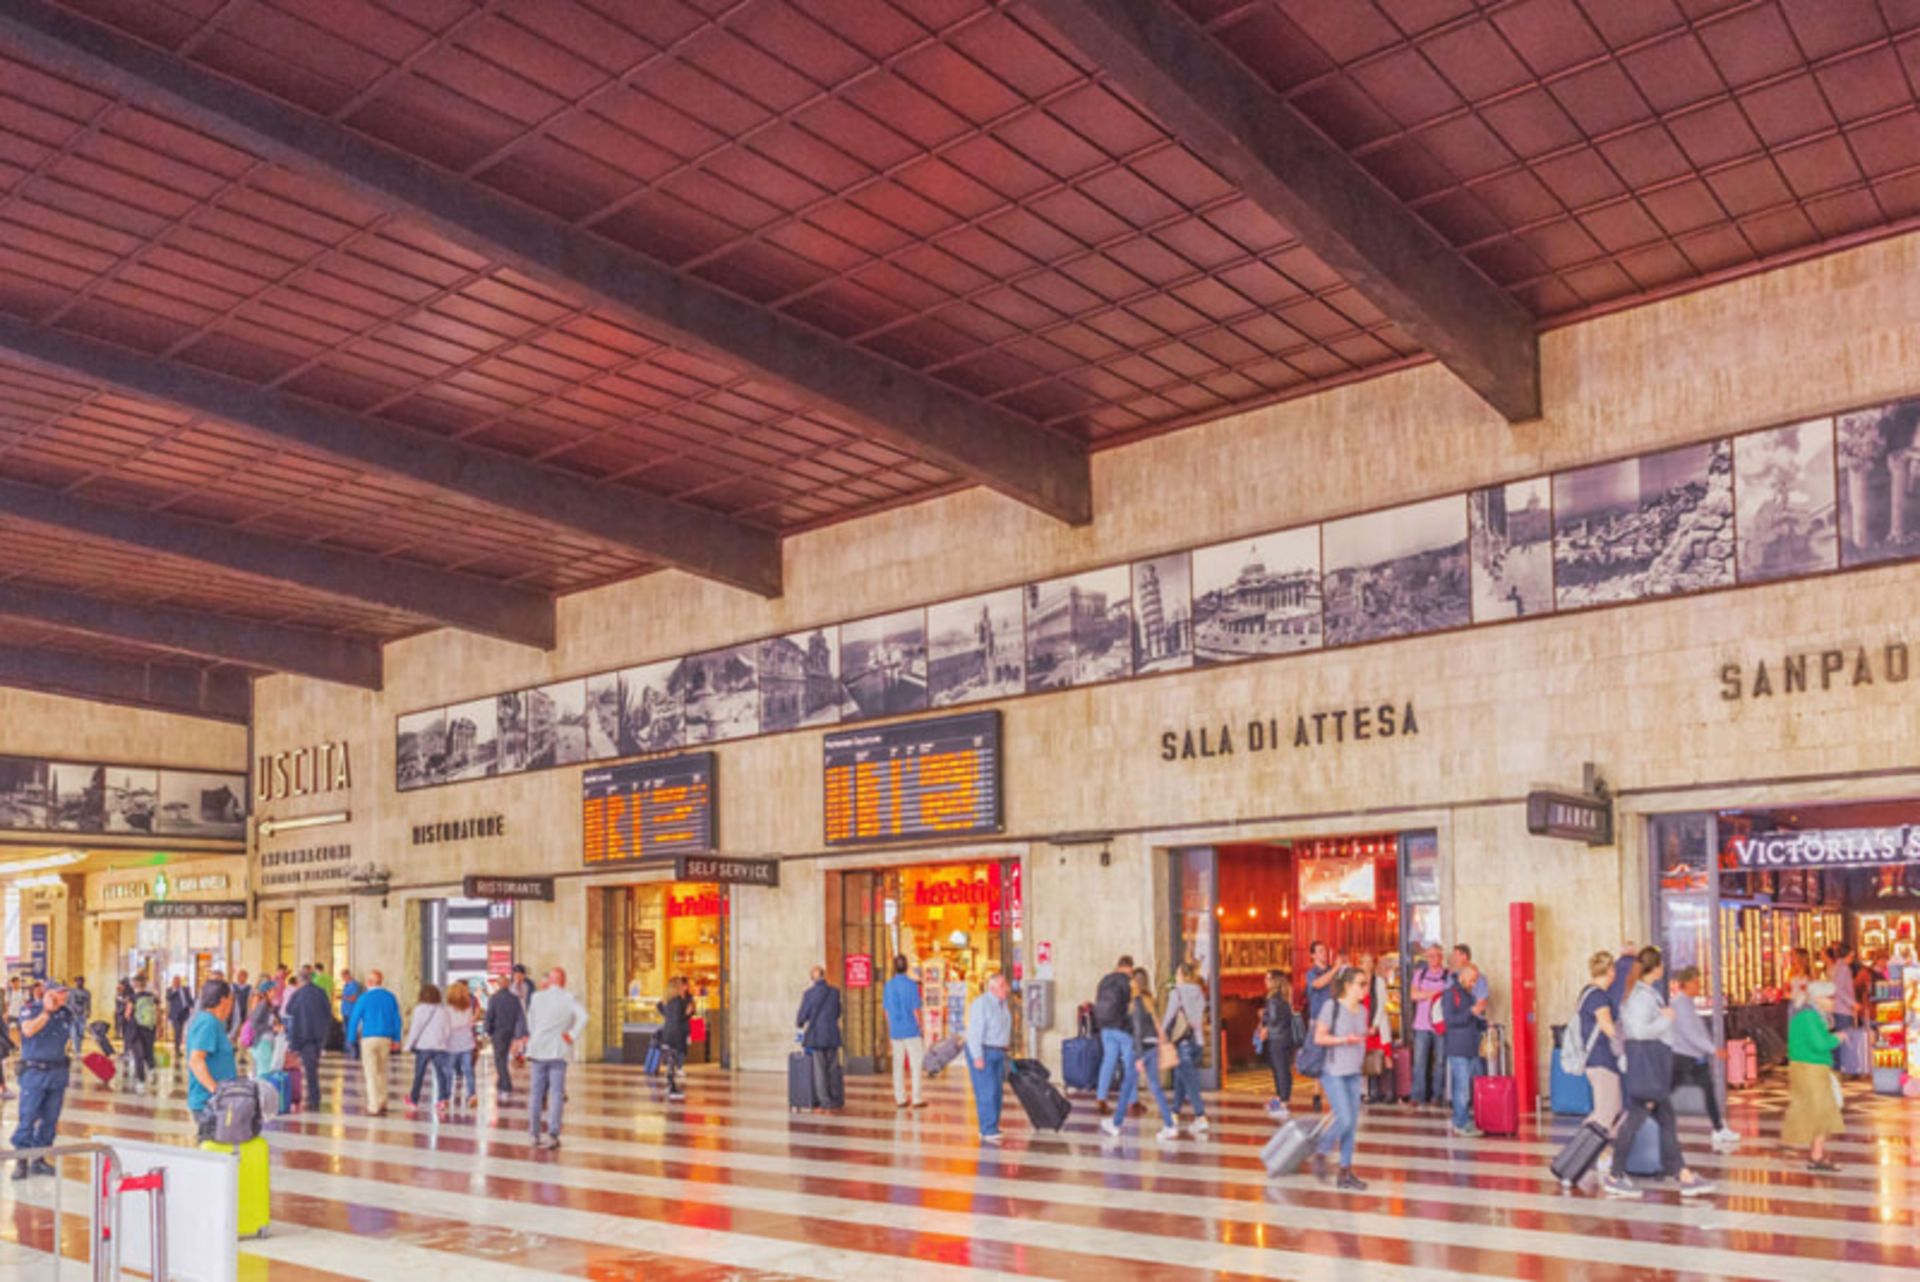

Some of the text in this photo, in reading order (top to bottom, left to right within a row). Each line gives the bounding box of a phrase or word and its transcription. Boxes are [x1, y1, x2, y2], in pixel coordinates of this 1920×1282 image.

[1720, 641, 1909, 701] SANPAO
[1161, 701, 1420, 762] SALA DI ATTESA
[259, 740, 352, 801] USCITA
[412, 814, 505, 846] RISTORATORE
[1557, 803, 1597, 829] BANCA
[1735, 829, 1896, 865] VICTORIA'S
[687, 860, 769, 879] SELF SERVICE
[476, 880, 543, 897] RISTORANTE
